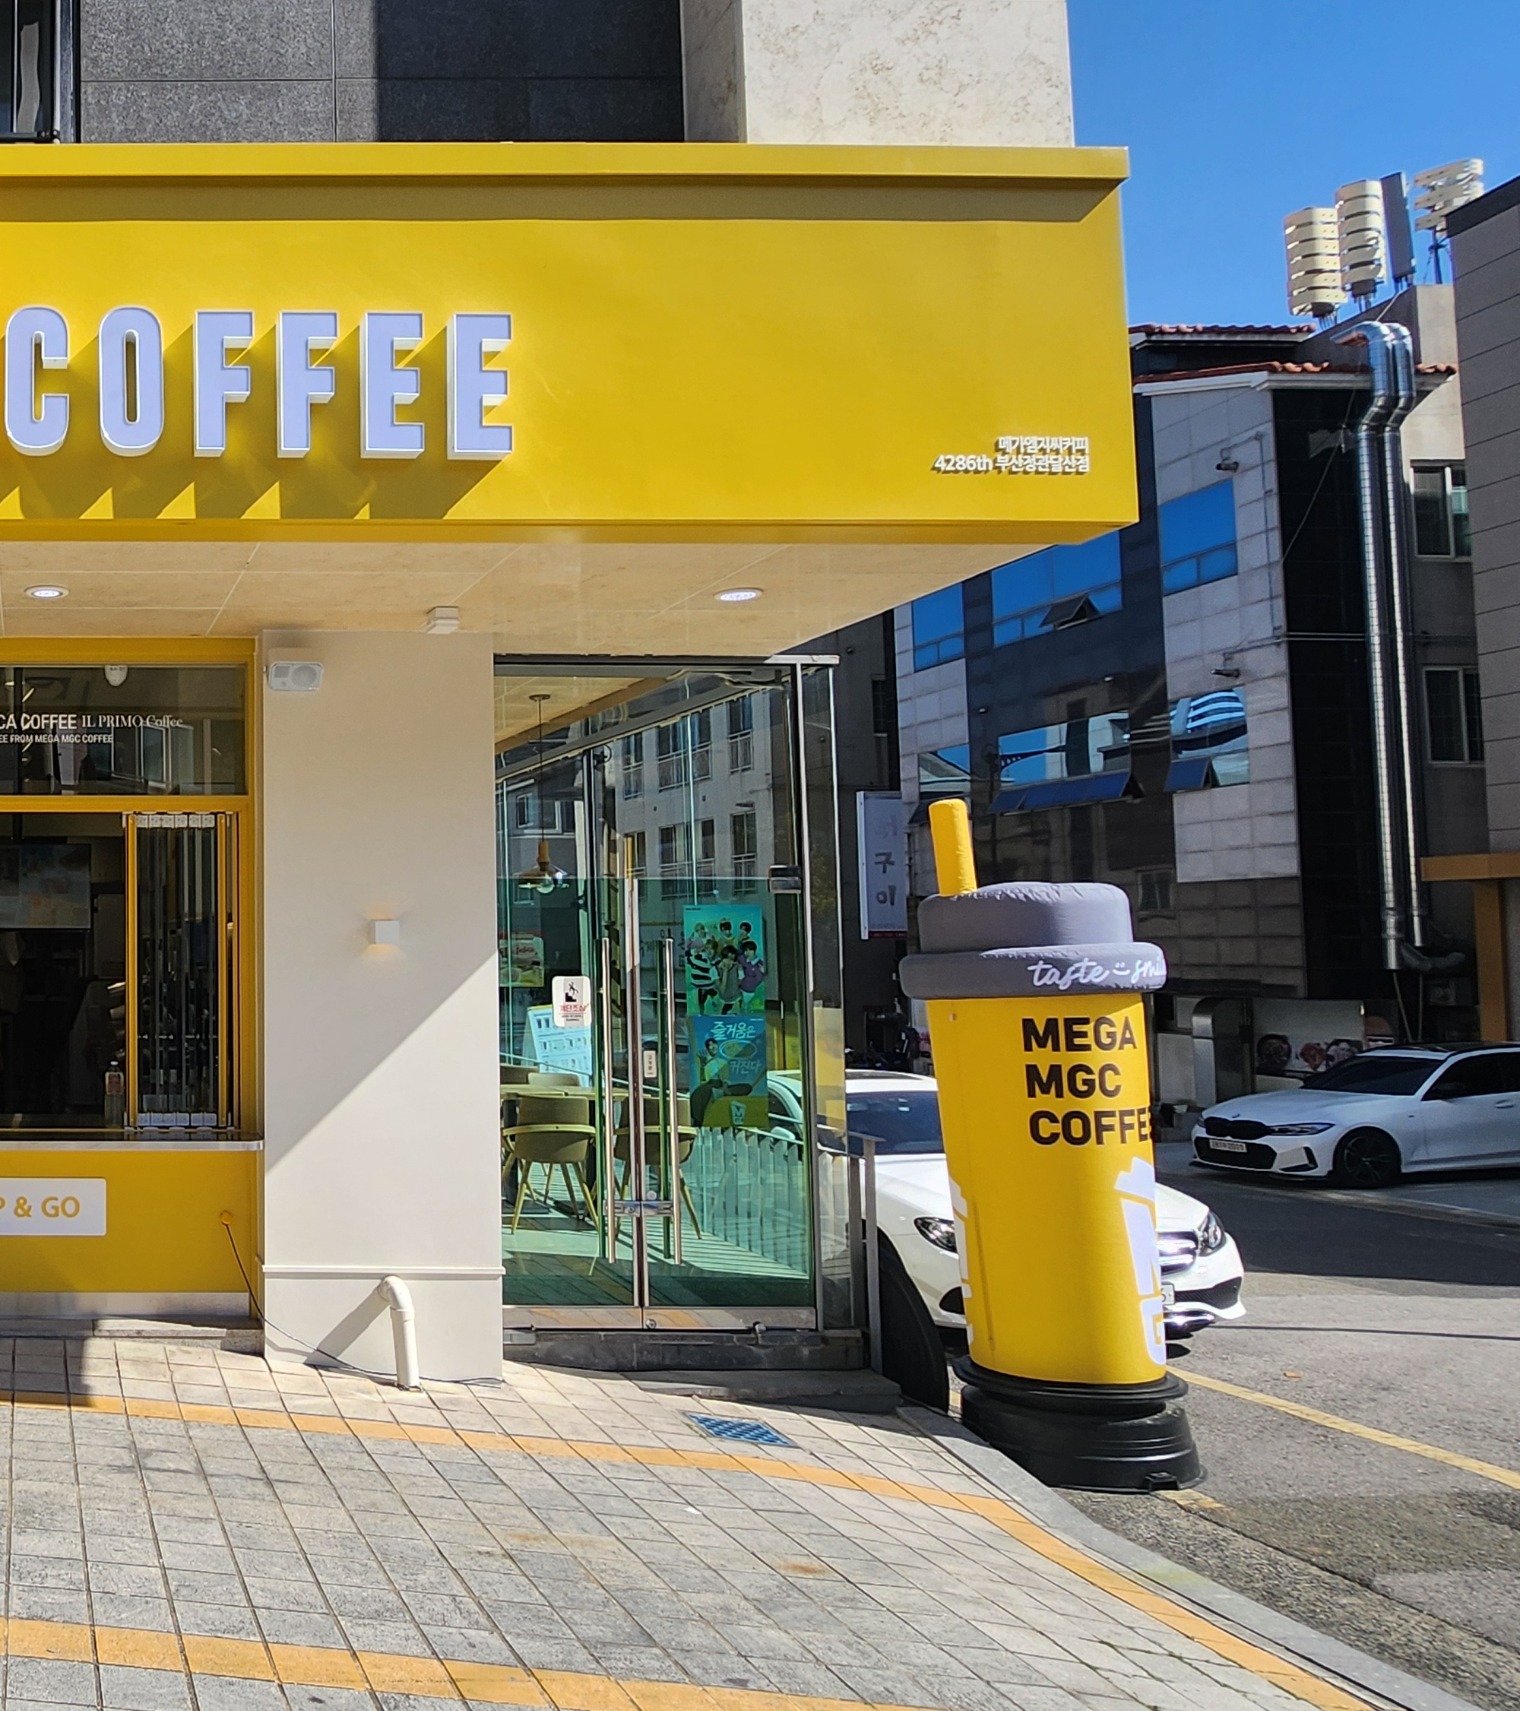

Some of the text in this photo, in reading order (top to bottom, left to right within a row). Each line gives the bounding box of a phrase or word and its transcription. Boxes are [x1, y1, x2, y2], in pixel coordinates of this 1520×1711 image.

[4, 304, 513, 460] COFFEE
[997, 436, 1090, 454] 메가엠지씨커피
[933, 454, 1091, 473] 4286th 부산정관달산점
[20, 713, 78, 730] COFFEE
[81, 714, 96, 728] IL
[98, 713, 144, 728] PRIMO
[145, 713, 184, 728] Coffee
[9, 734, 33, 744] FROM
[34, 734, 60, 744] MEGA
[61, 734, 81, 744] MGC
[82, 734, 114, 744] COFFEE
[1027, 956, 1168, 990] taste smil
[710, 1021, 756, 1041] 즐거움은
[1021, 1016, 1138, 1052] MEGA
[1024, 1063, 1122, 1099] MGC
[1028, 1107, 1153, 1146] COFFE
[13, 1195, 32, 1218] &
[40, 1195, 81, 1218] GO
